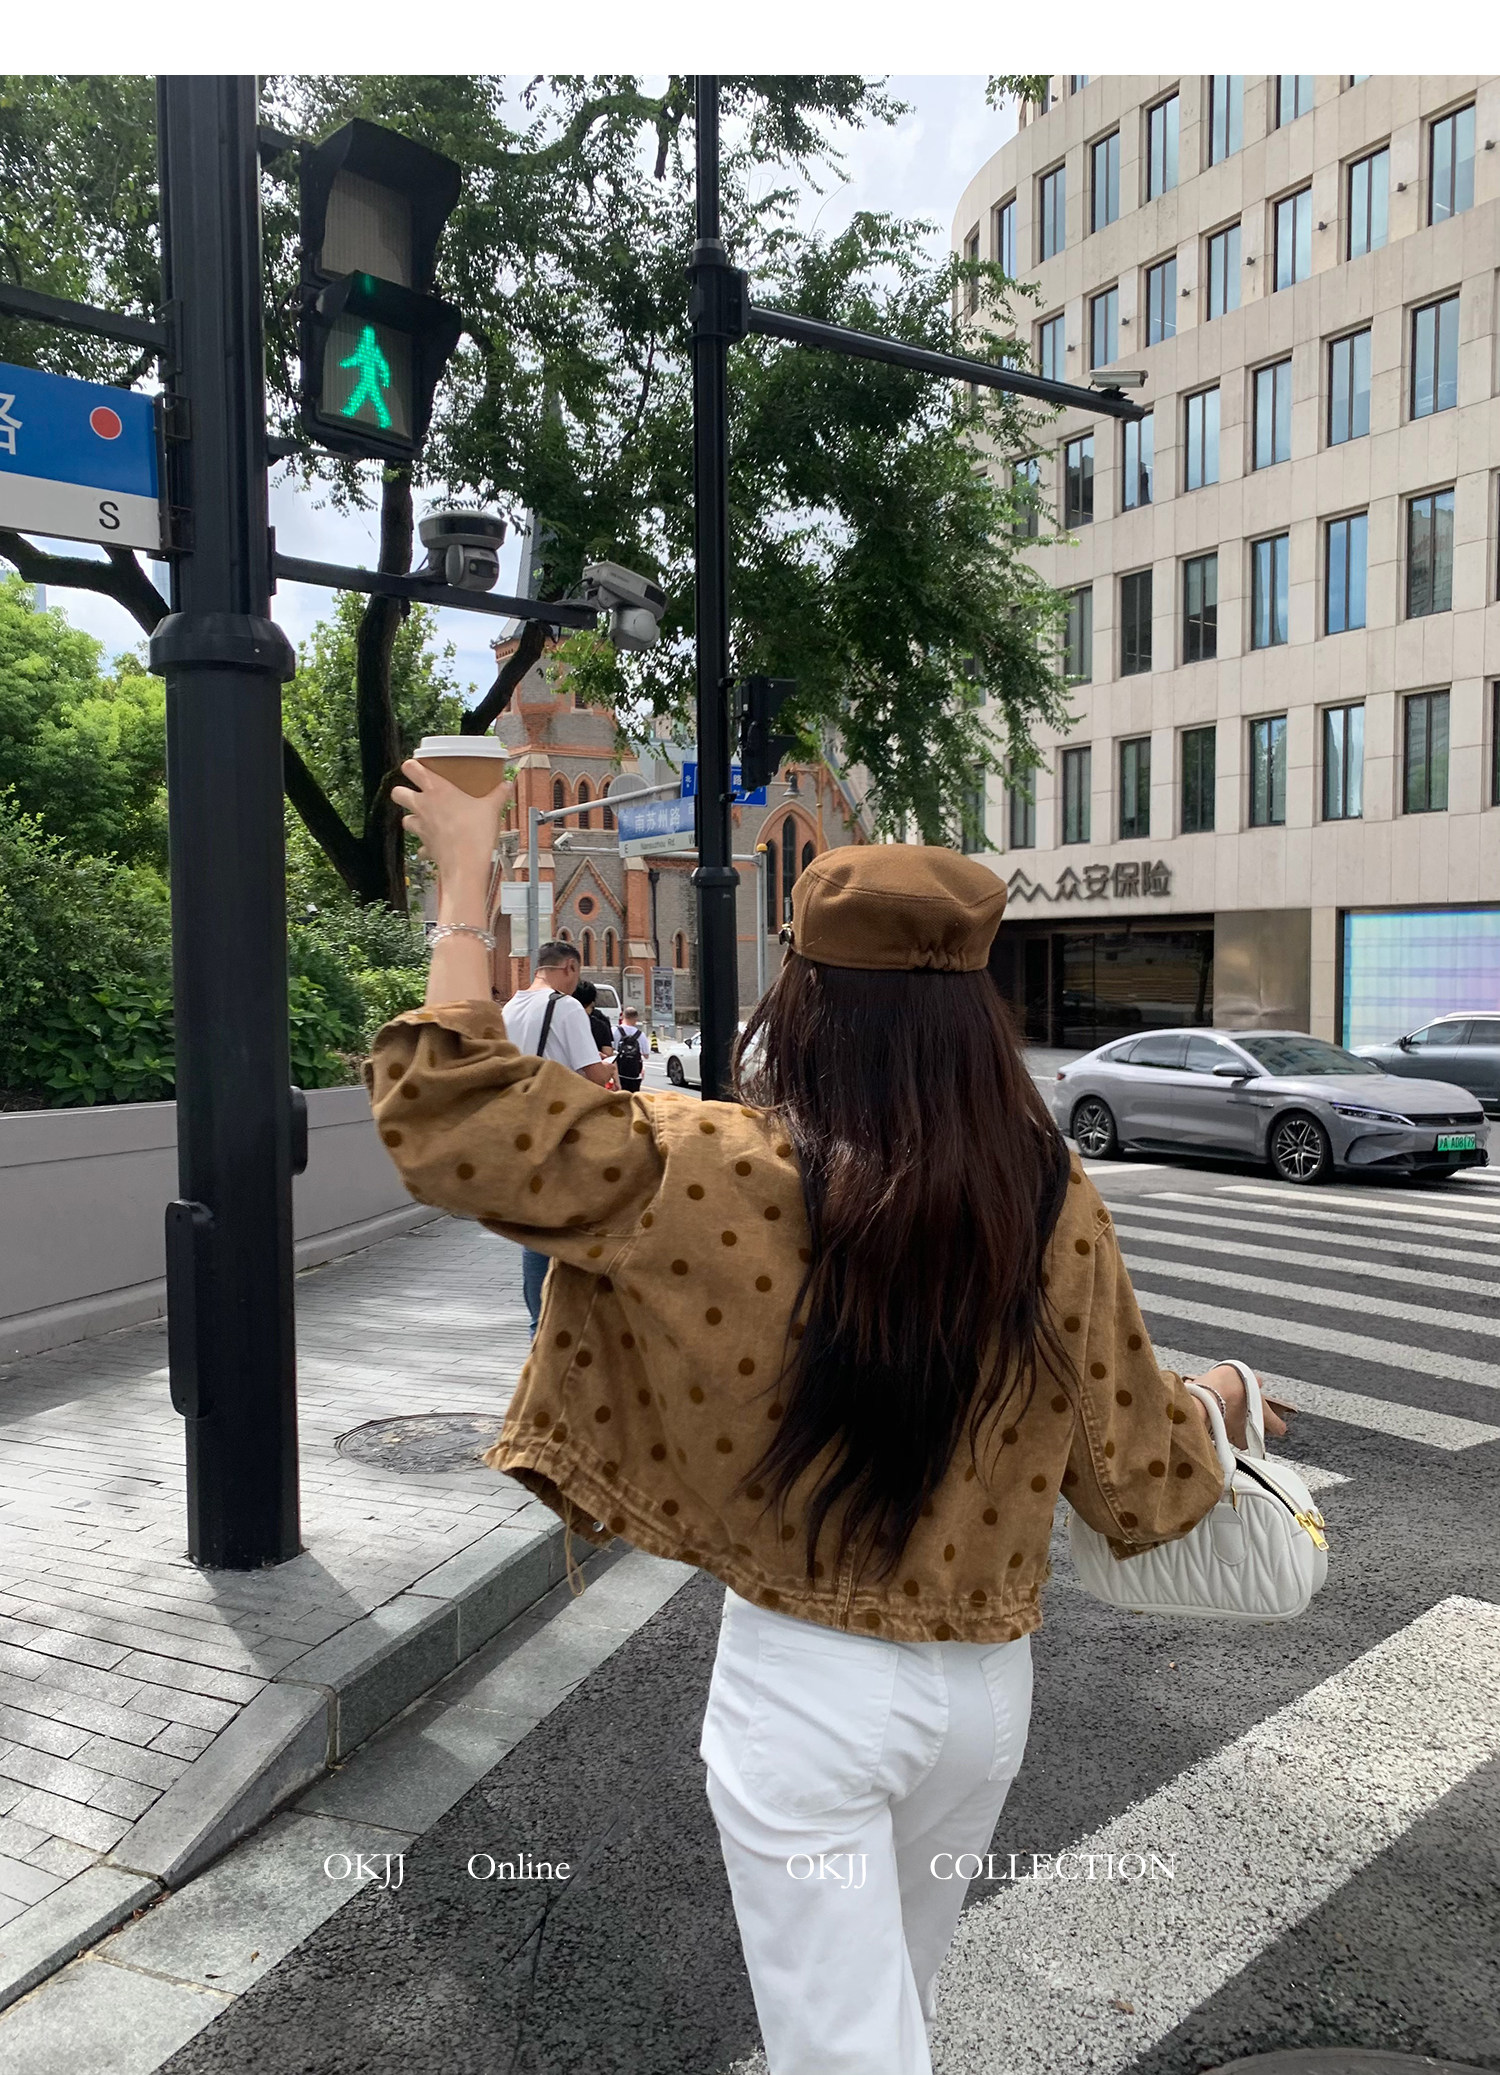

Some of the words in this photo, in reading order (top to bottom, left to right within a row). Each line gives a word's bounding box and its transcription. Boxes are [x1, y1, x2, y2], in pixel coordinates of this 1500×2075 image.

[99, 501, 120, 530] S
[634, 807, 681, 833] 南苏州路
[1055, 859, 1173, 901] 众安保险
